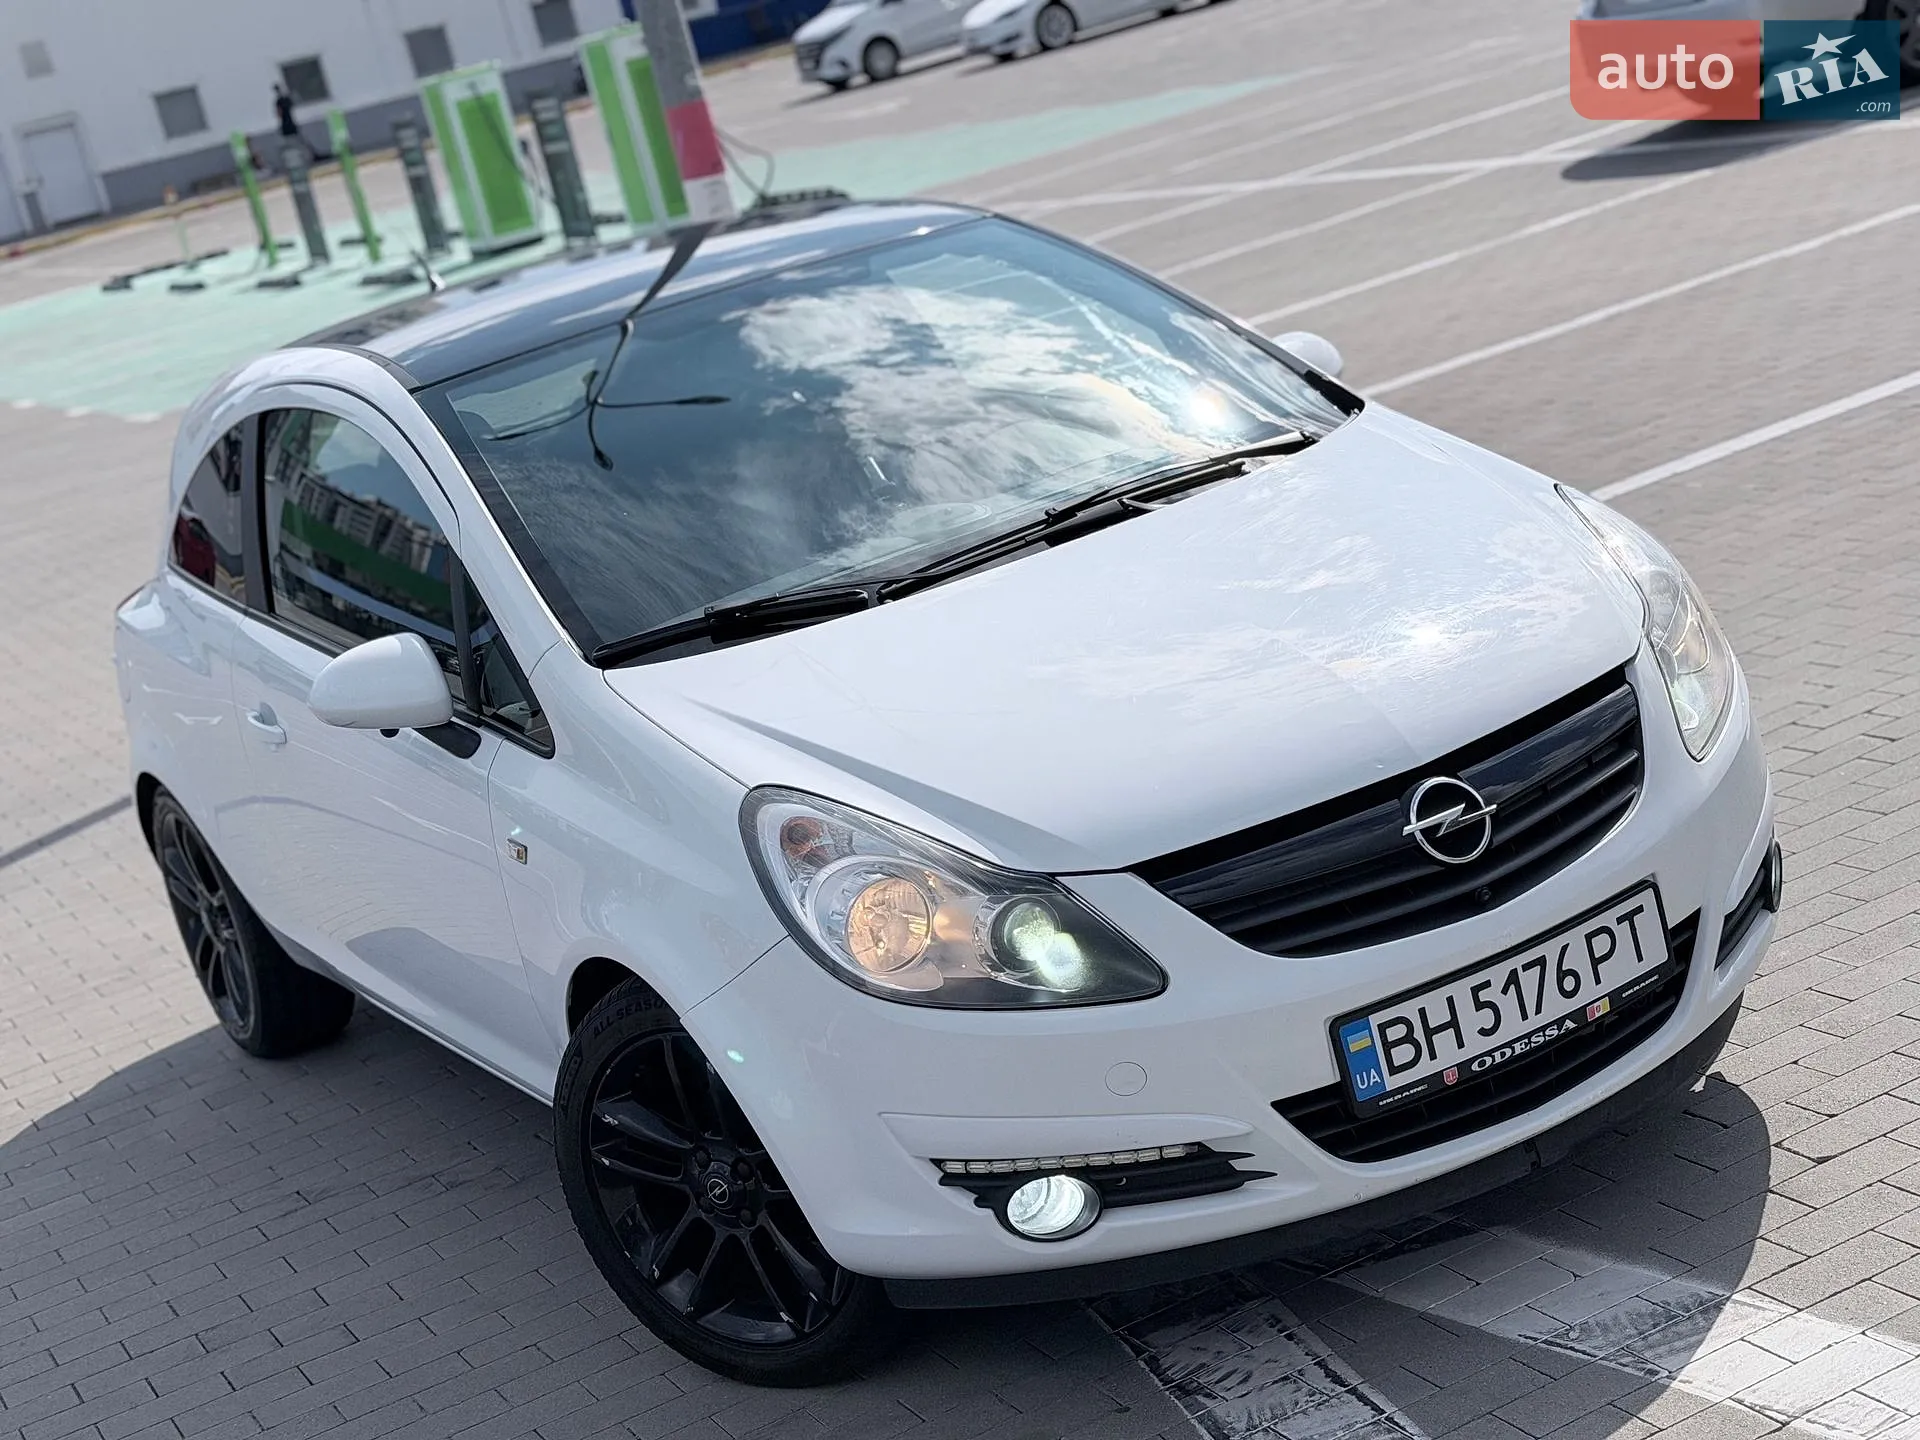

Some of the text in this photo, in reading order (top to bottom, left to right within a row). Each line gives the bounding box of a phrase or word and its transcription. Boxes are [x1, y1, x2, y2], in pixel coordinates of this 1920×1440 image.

[1376, 904, 1645, 1077] BH 5176 PT
[592, 997, 664, 1039] ALL SEASO
[1470, 1018, 1578, 1072] ODESSA
[1355, 1069, 1381, 1091] UA
